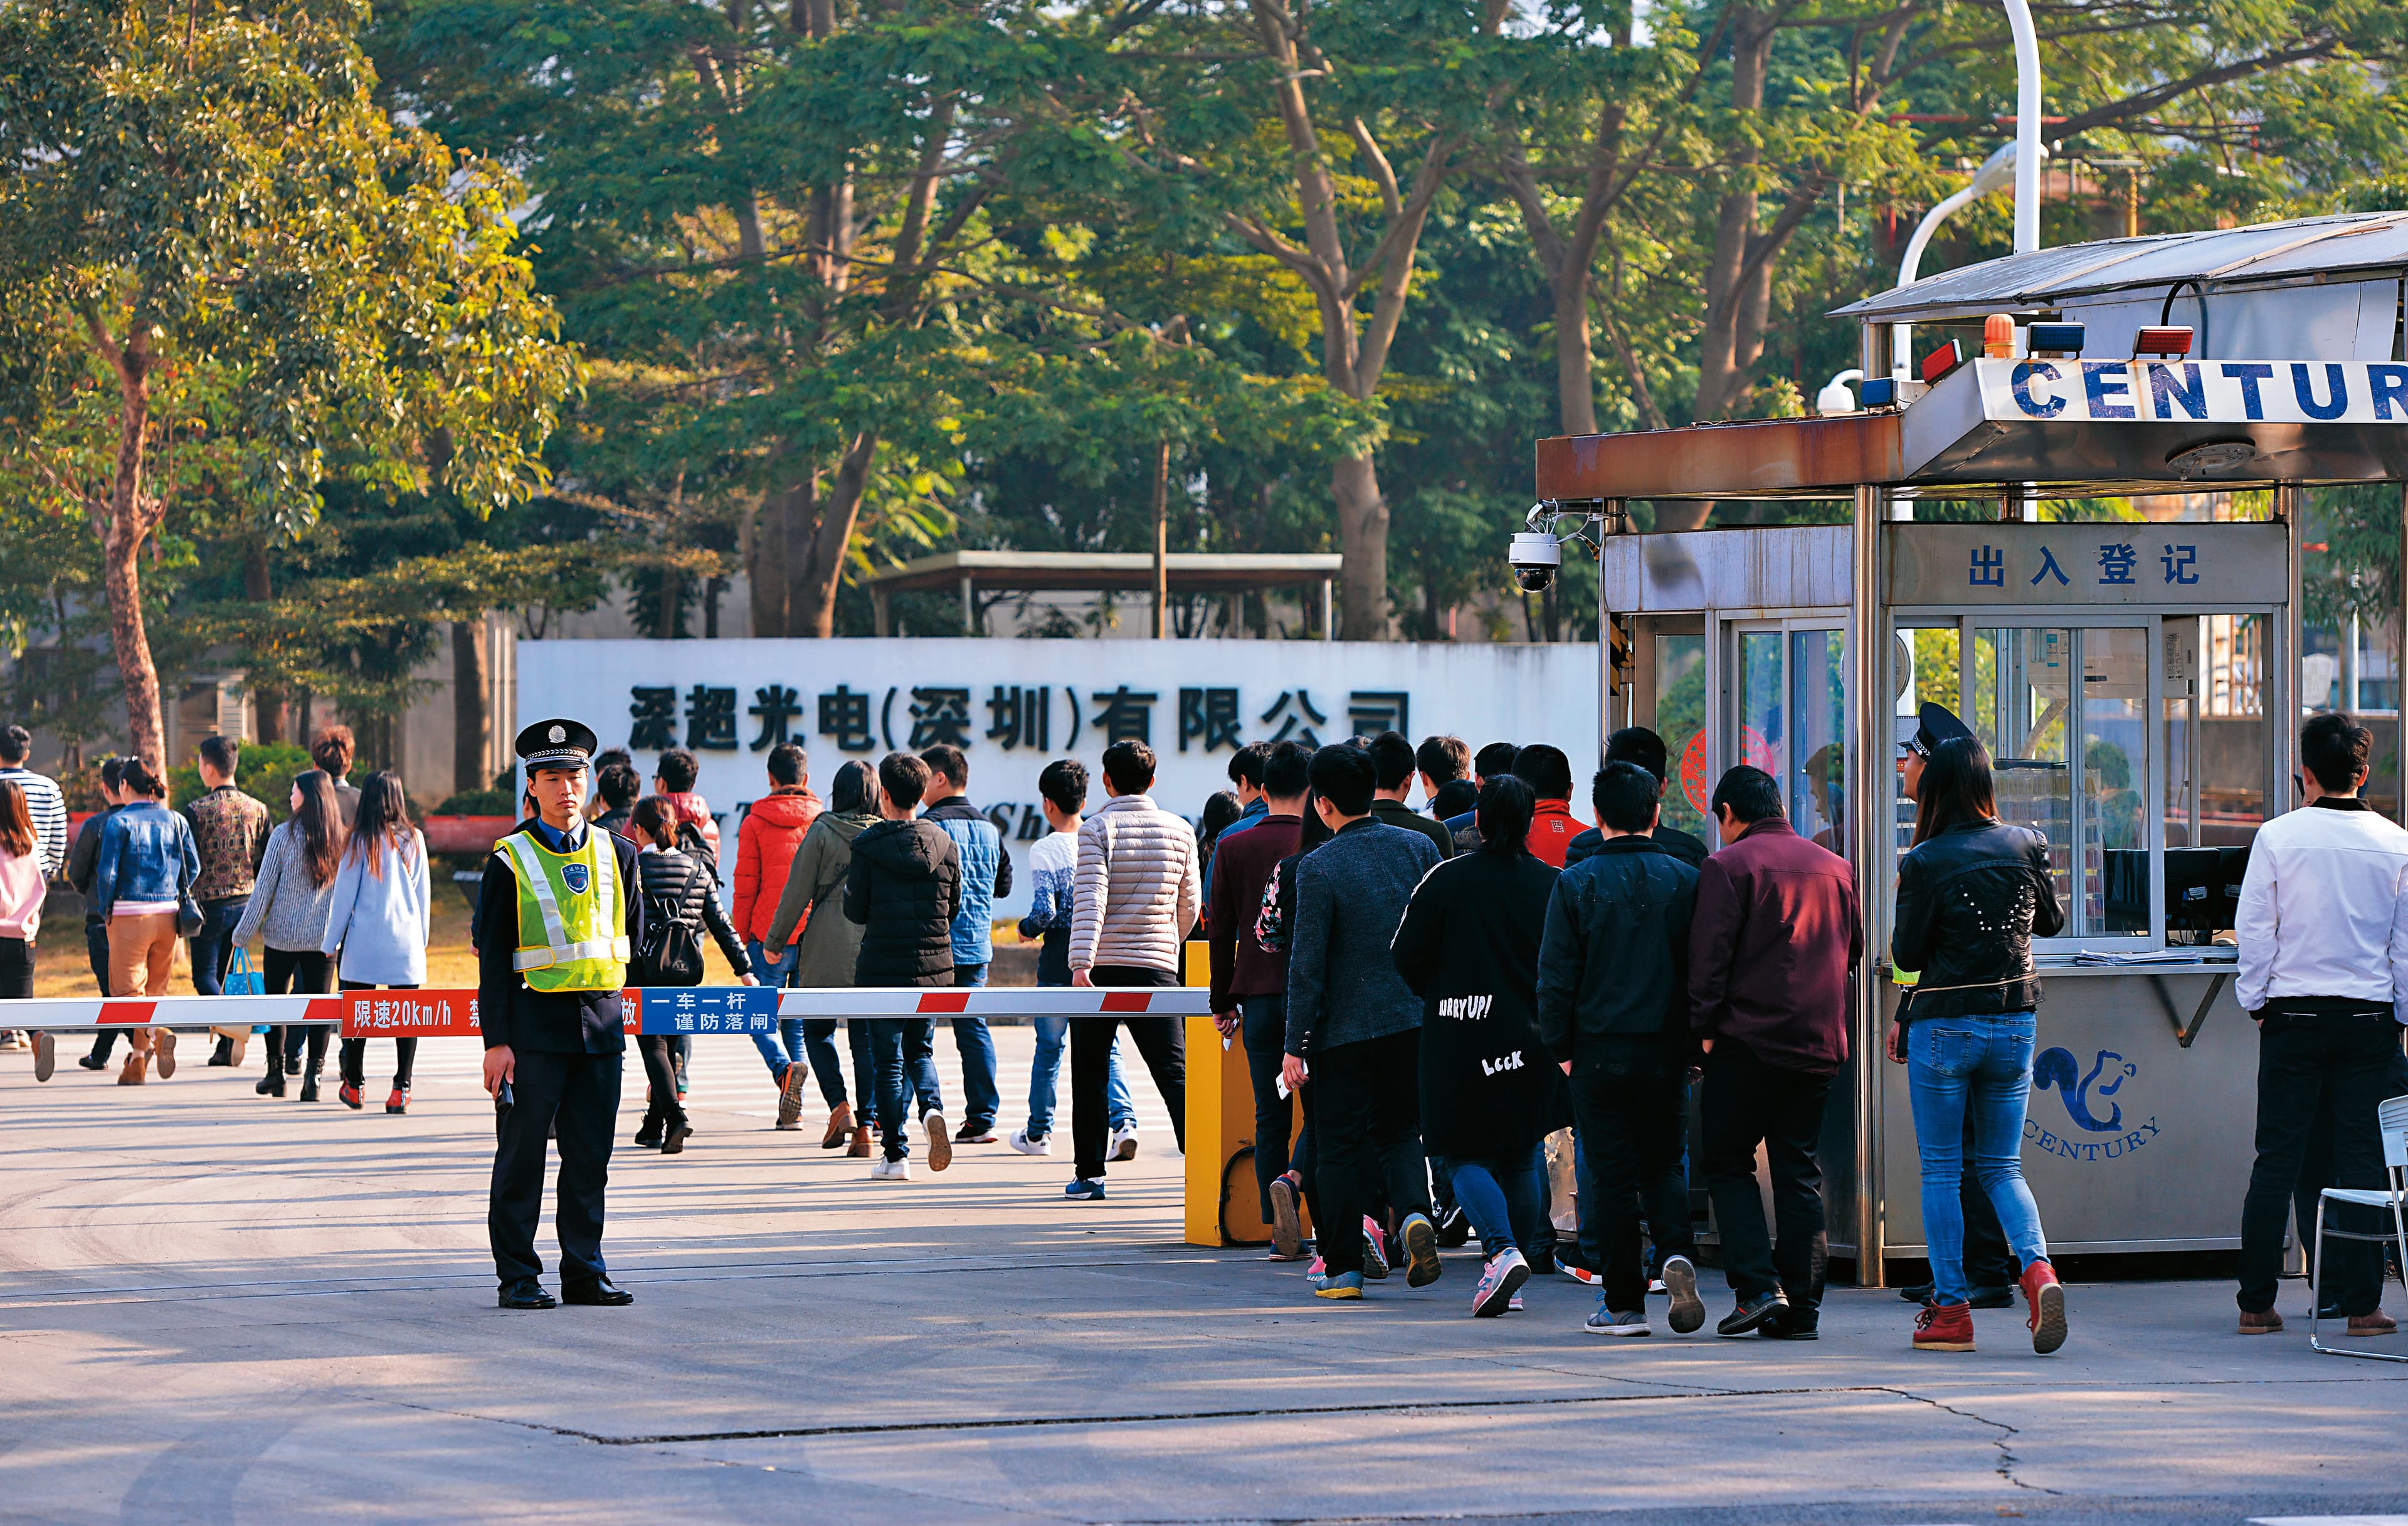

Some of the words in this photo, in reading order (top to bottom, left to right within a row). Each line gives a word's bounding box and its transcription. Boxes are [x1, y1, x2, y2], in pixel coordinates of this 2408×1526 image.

[1969, 544, 2199, 587] 出入登记
[628, 684, 1409, 752] 深超光电(深圳)有限公司
[354, 999, 451, 1028] 限速20km/h
[651, 992, 746, 1010] 一车一杆
[675, 1013, 768, 1030] 谨防落闸
[2023, 1116, 2161, 1162] CENTURY
